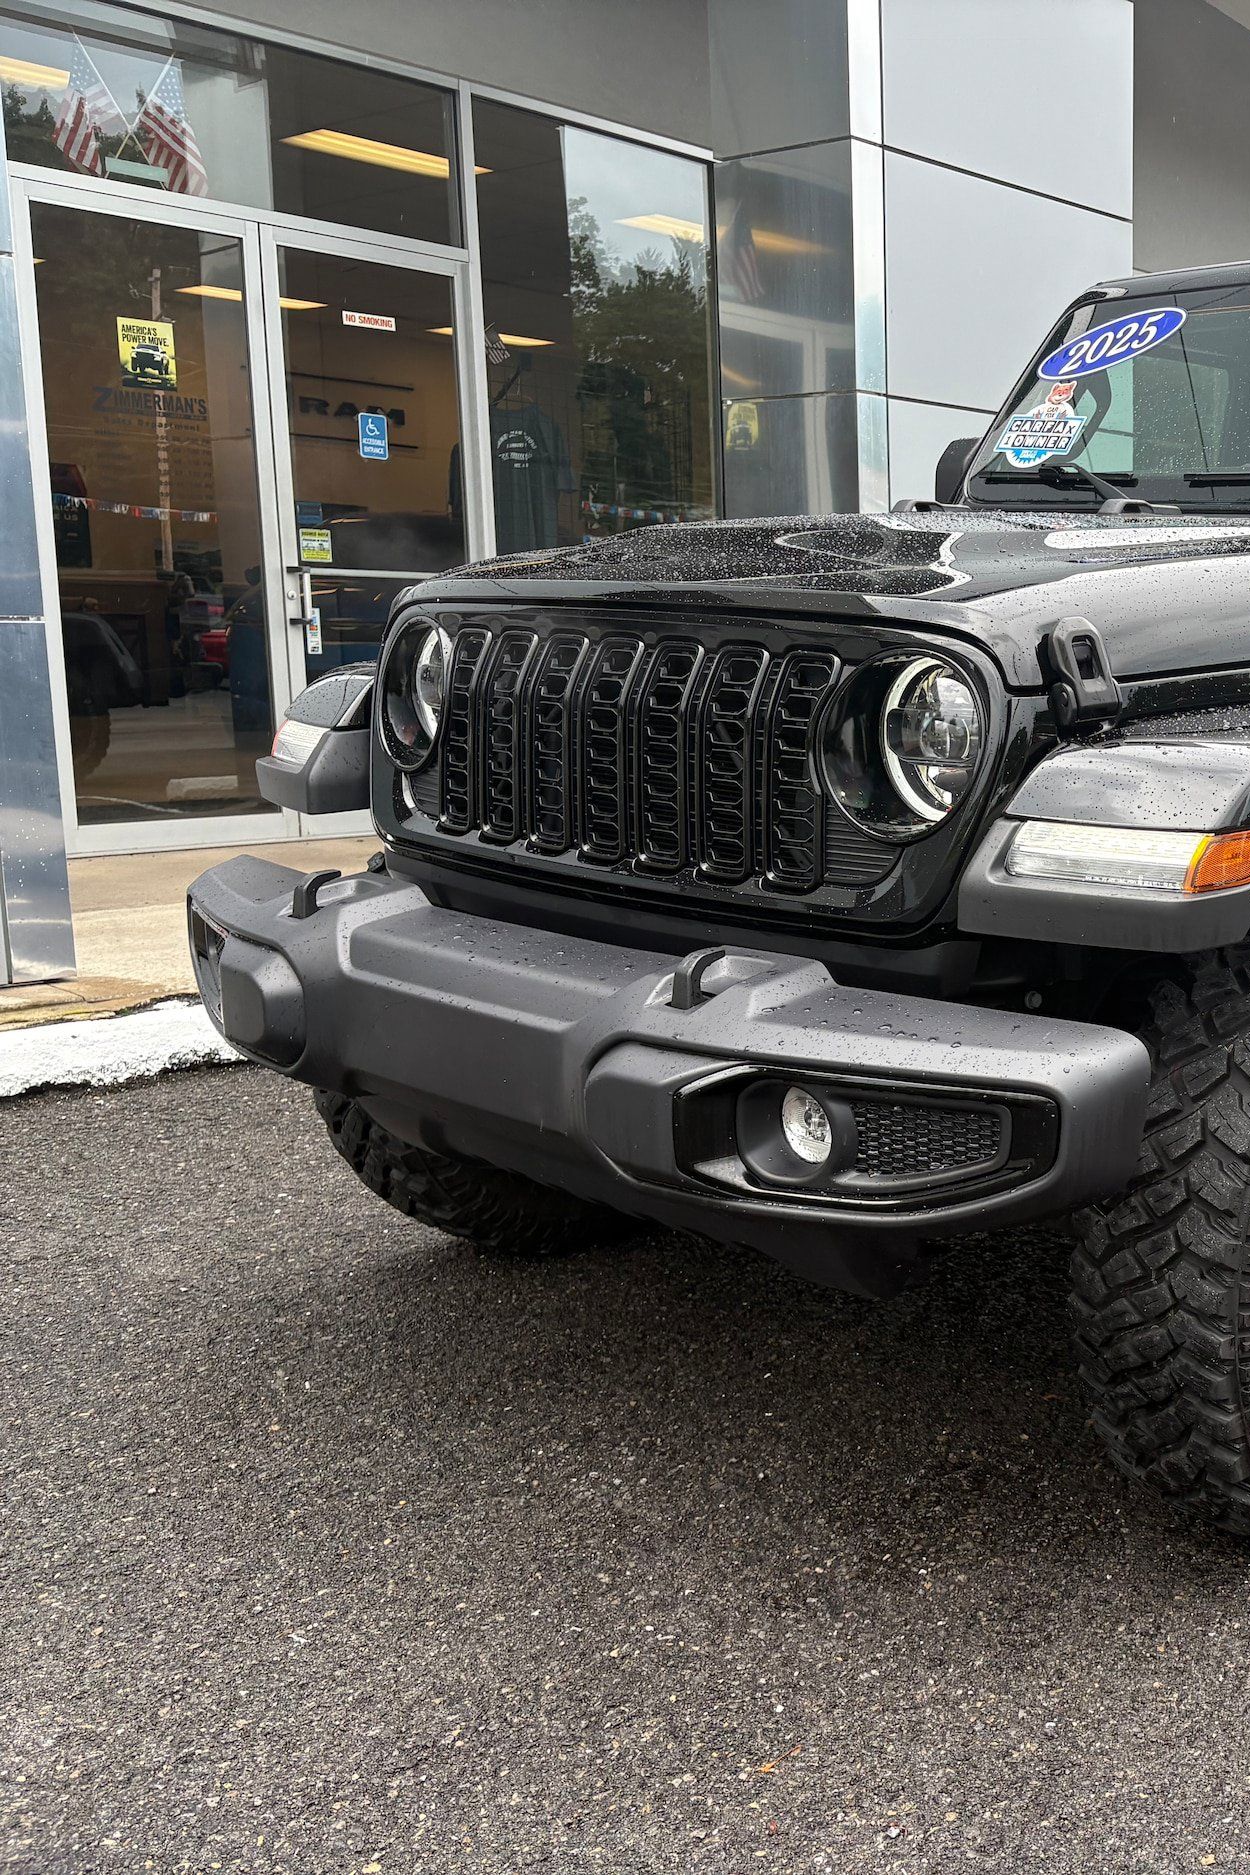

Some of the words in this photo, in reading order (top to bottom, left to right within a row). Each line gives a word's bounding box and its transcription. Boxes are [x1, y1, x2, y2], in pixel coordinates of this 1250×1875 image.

[345, 313, 356, 323] NO
[358, 315, 393, 328] SMOKING
[121, 324, 158, 337] AMERICA'S
[122, 333, 147, 344] POWER
[148, 336, 170, 347] MOVE.
[1058, 312, 1166, 375] 2025
[92, 385, 207, 415] ZIMMERMAN'S
[1011, 420, 1075, 435] CARFAX
[1012, 434, 1072, 450] OWNER
